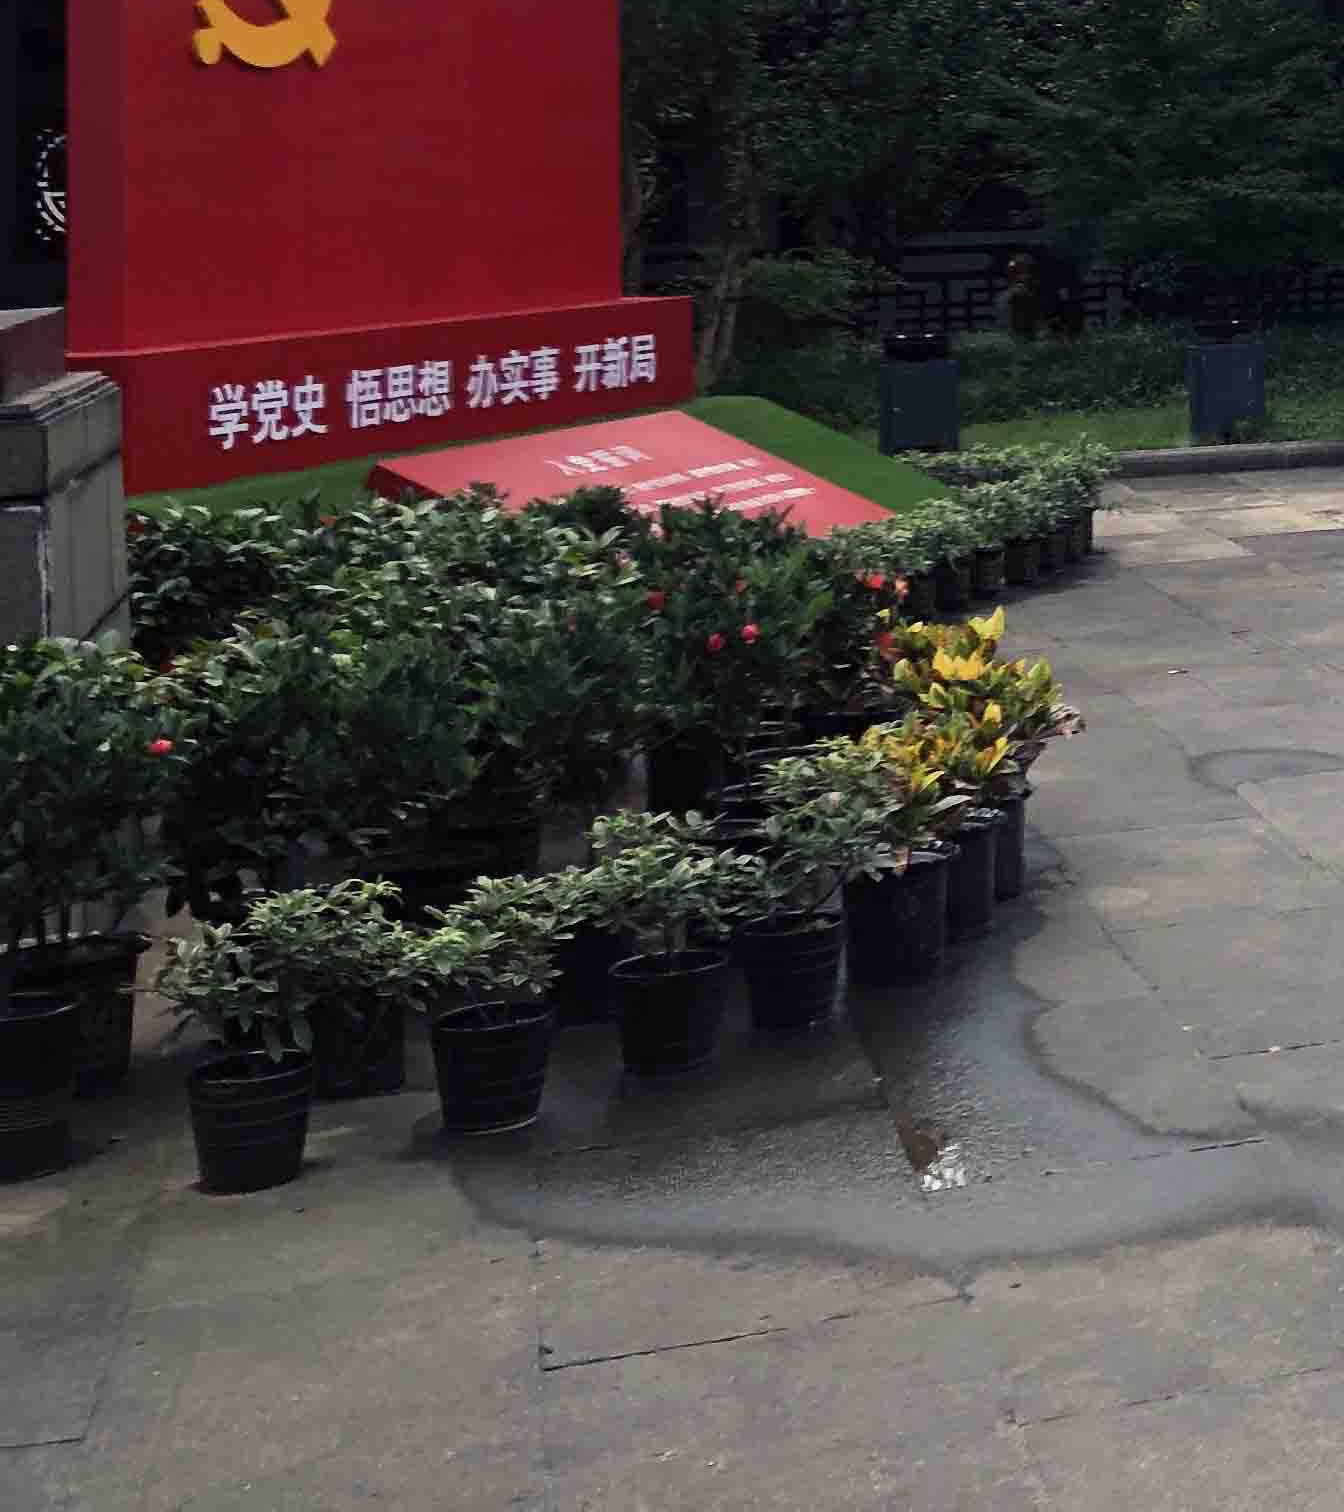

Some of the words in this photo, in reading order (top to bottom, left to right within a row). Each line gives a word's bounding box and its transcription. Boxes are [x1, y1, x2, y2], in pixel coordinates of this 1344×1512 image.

[209, 375, 328, 450] 学党史
[345, 360, 451, 430] 悟思想
[466, 345, 560, 408] 办实事
[573, 334, 656, 392] 开新局
